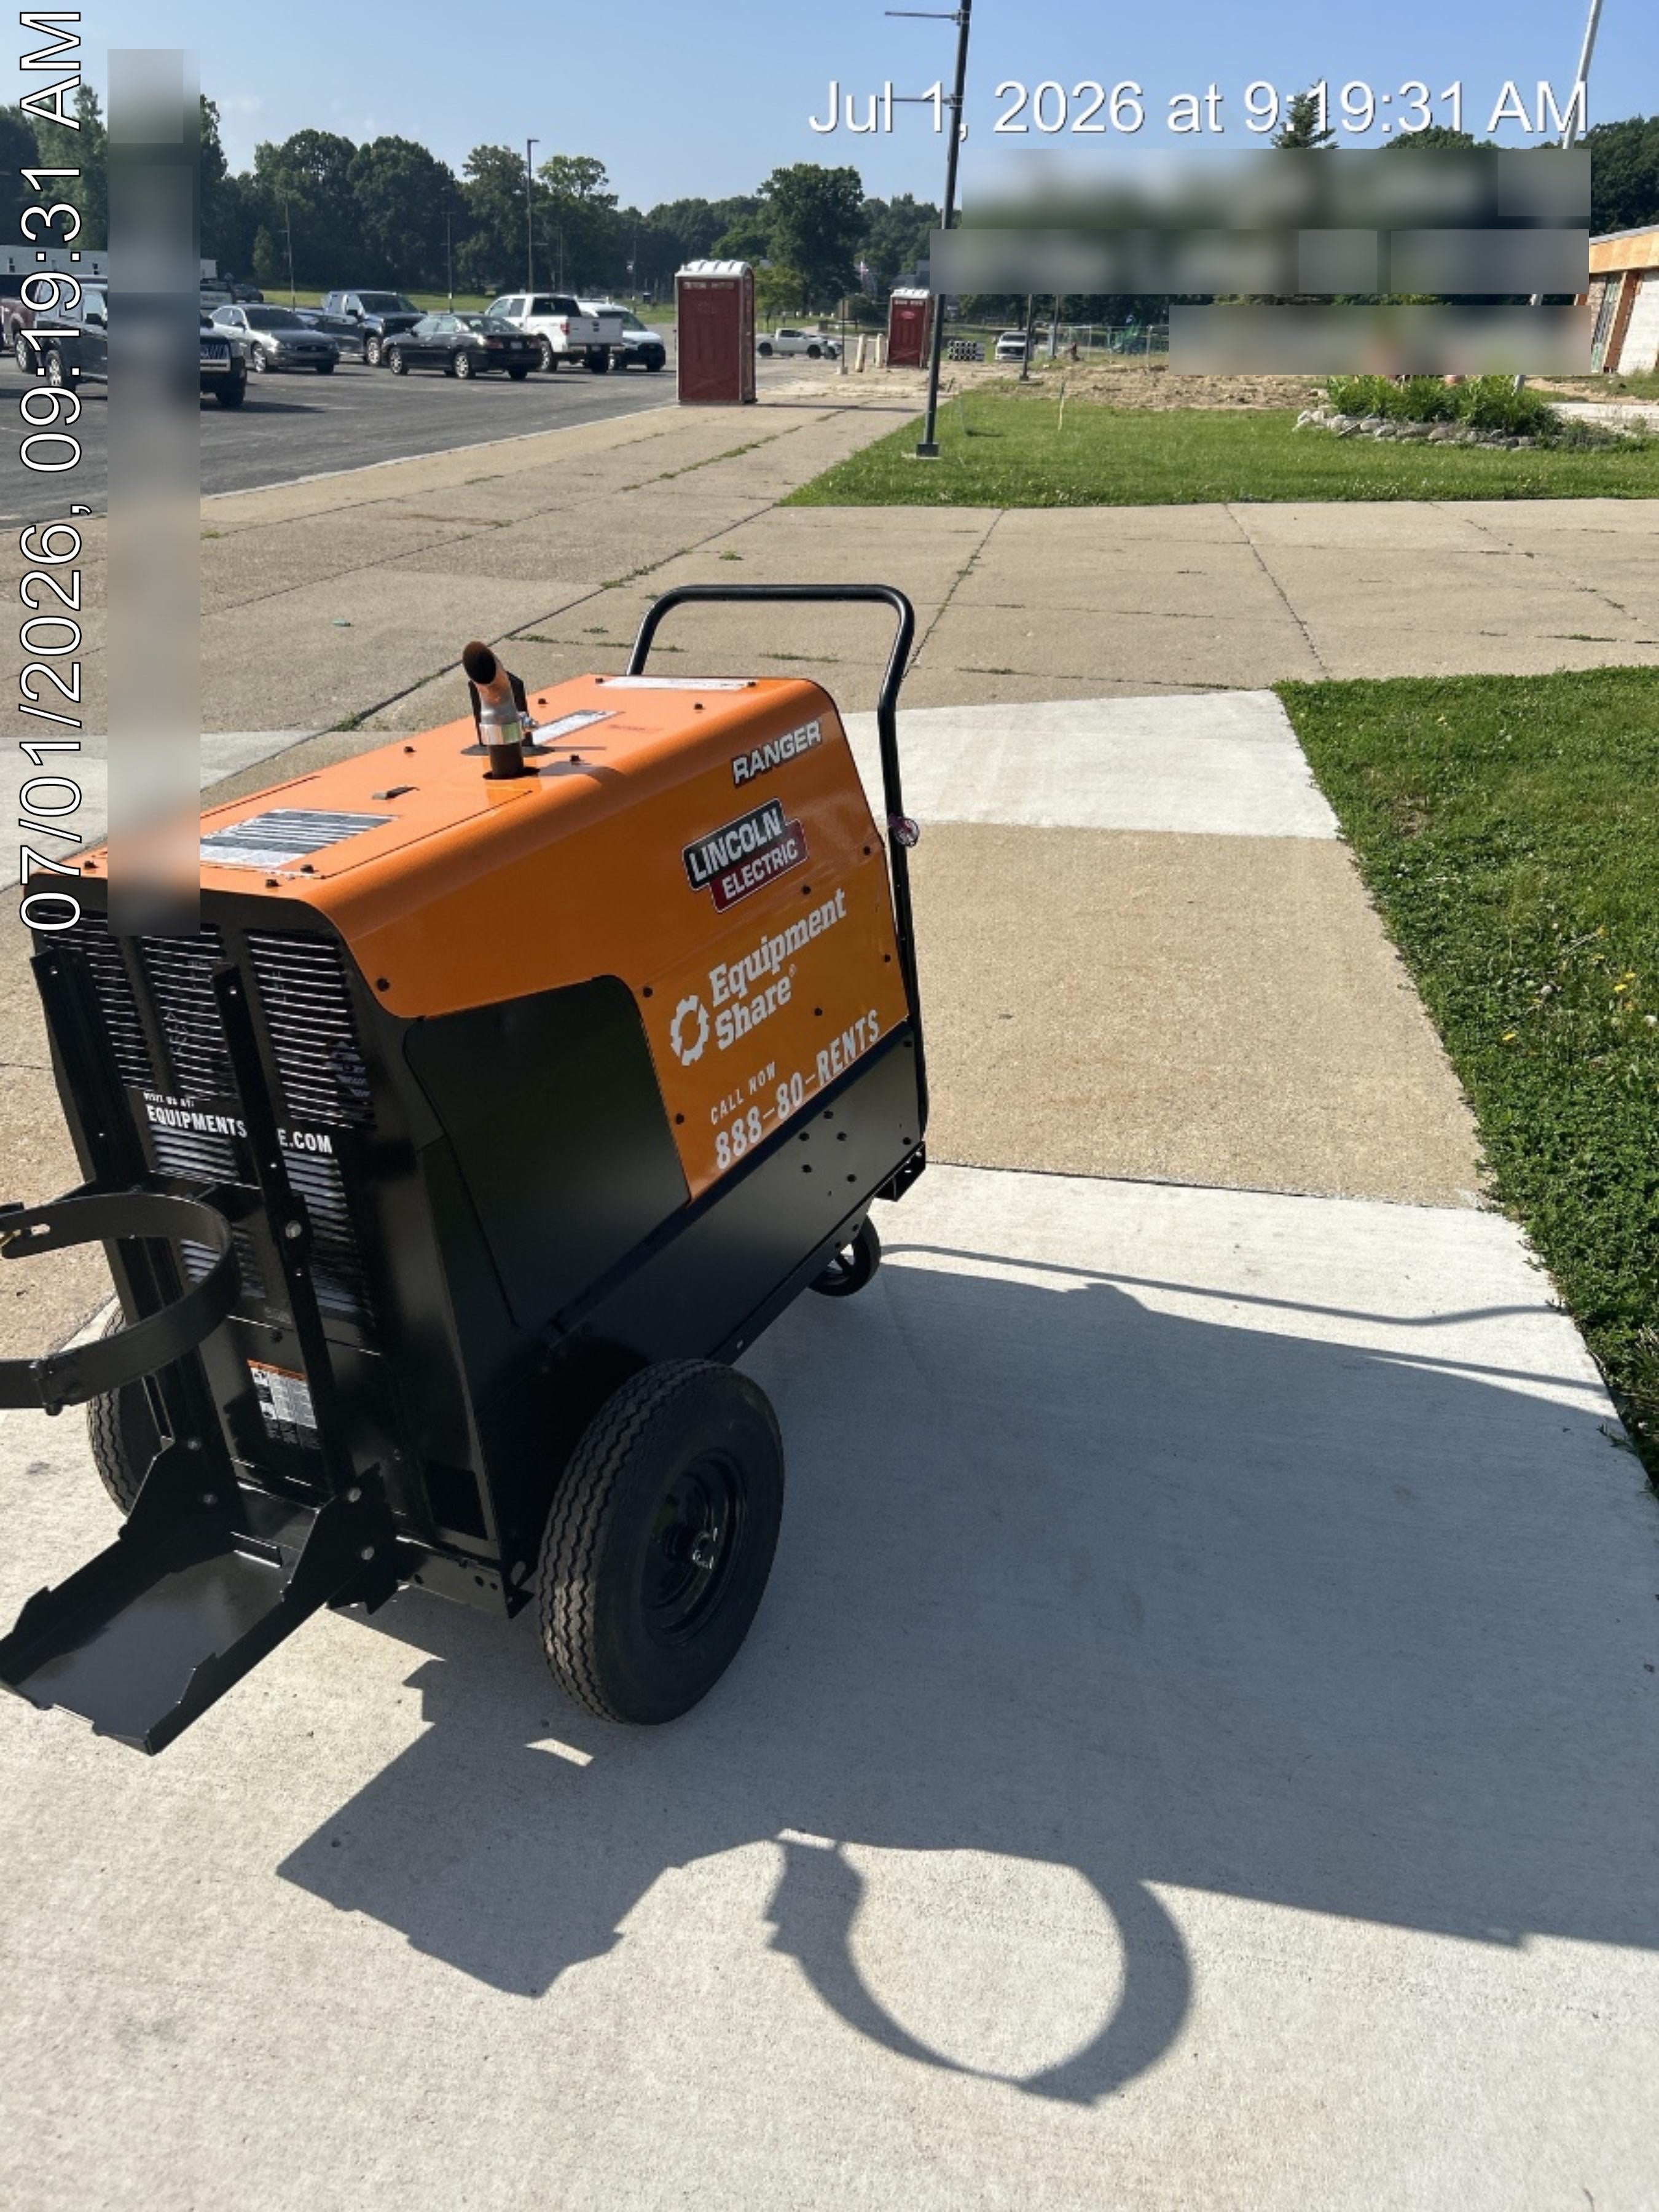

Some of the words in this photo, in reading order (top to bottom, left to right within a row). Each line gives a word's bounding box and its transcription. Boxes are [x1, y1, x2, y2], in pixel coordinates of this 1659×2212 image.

[733, 721, 821, 785] RANGER
[689, 807, 783, 881] LINCOLN
[722, 839, 798, 900] ELECTRIC
[708, 888, 847, 1008] Equipment
[711, 1089, 744, 1125] CALL
[748, 1061, 776, 1095] NOW
[715, 1009, 880, 1170] 888-80-RENTS
